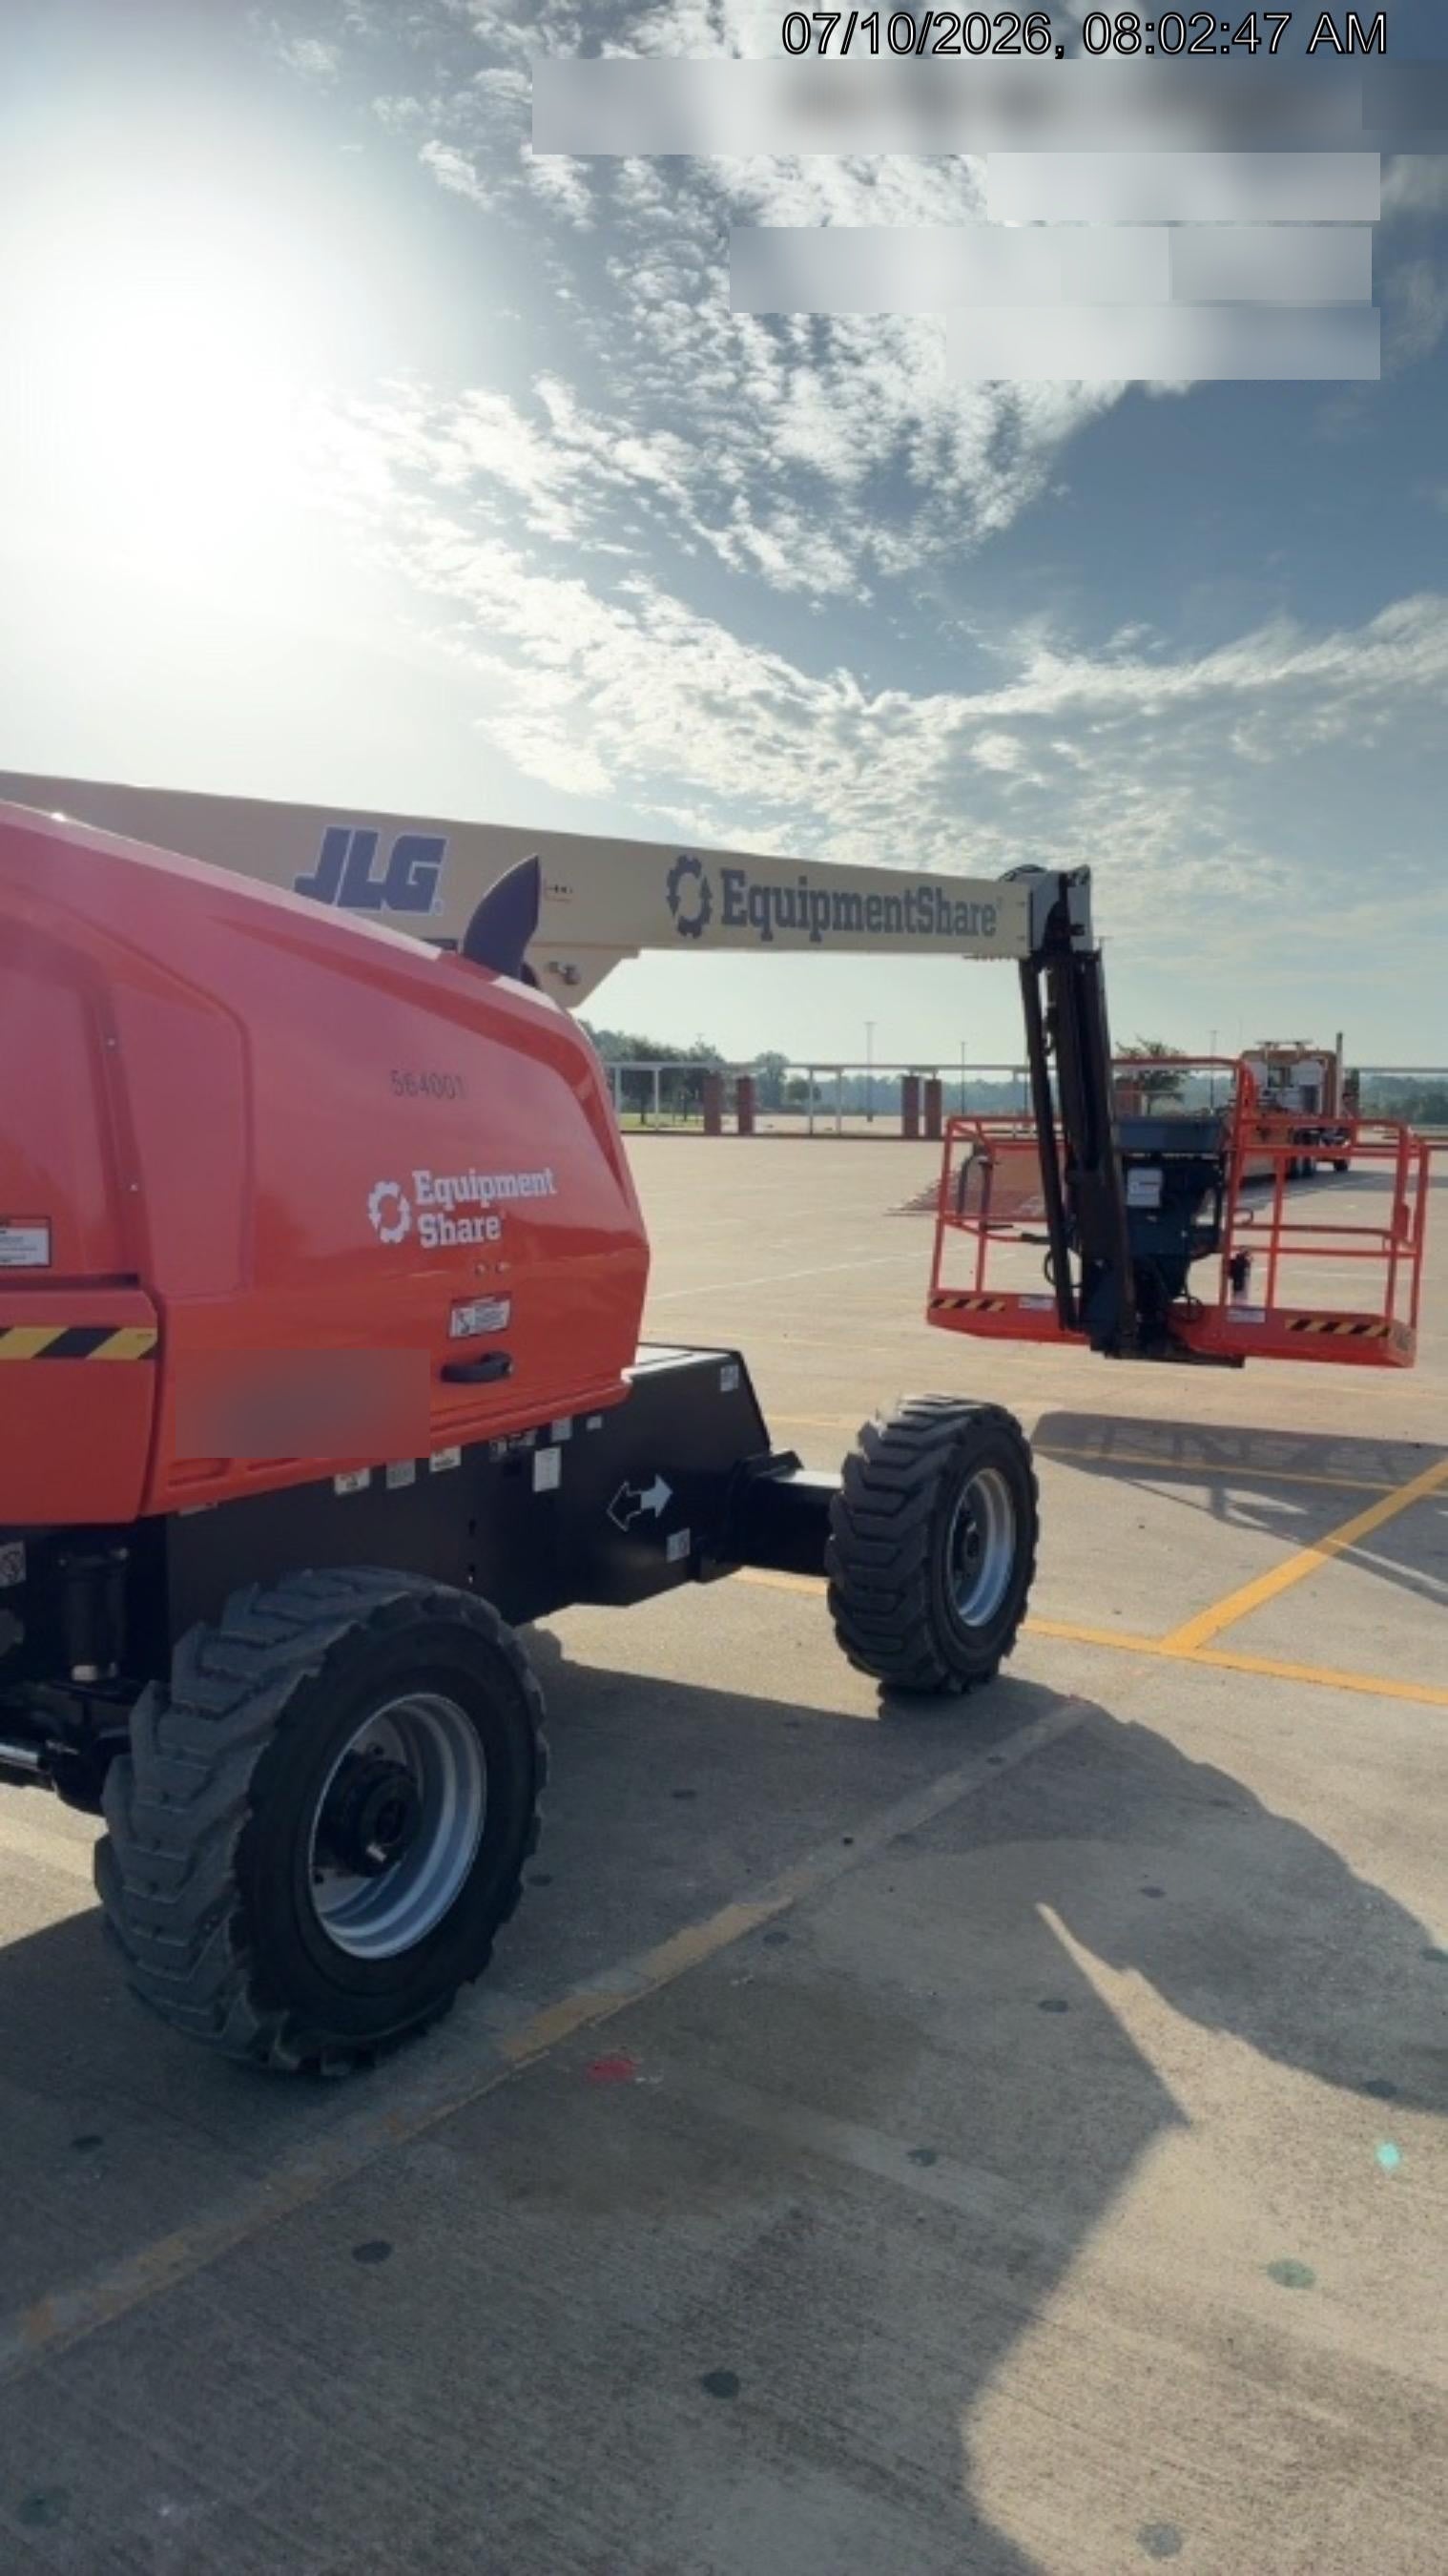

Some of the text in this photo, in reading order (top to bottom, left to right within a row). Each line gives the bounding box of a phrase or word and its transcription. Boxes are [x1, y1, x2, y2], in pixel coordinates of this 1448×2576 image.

[294, 824, 449, 915] JLG
[720, 867, 998, 943] EquipmentShare
[412, 1168, 557, 1211] Equipment
[417, 1213, 502, 1248] Share
